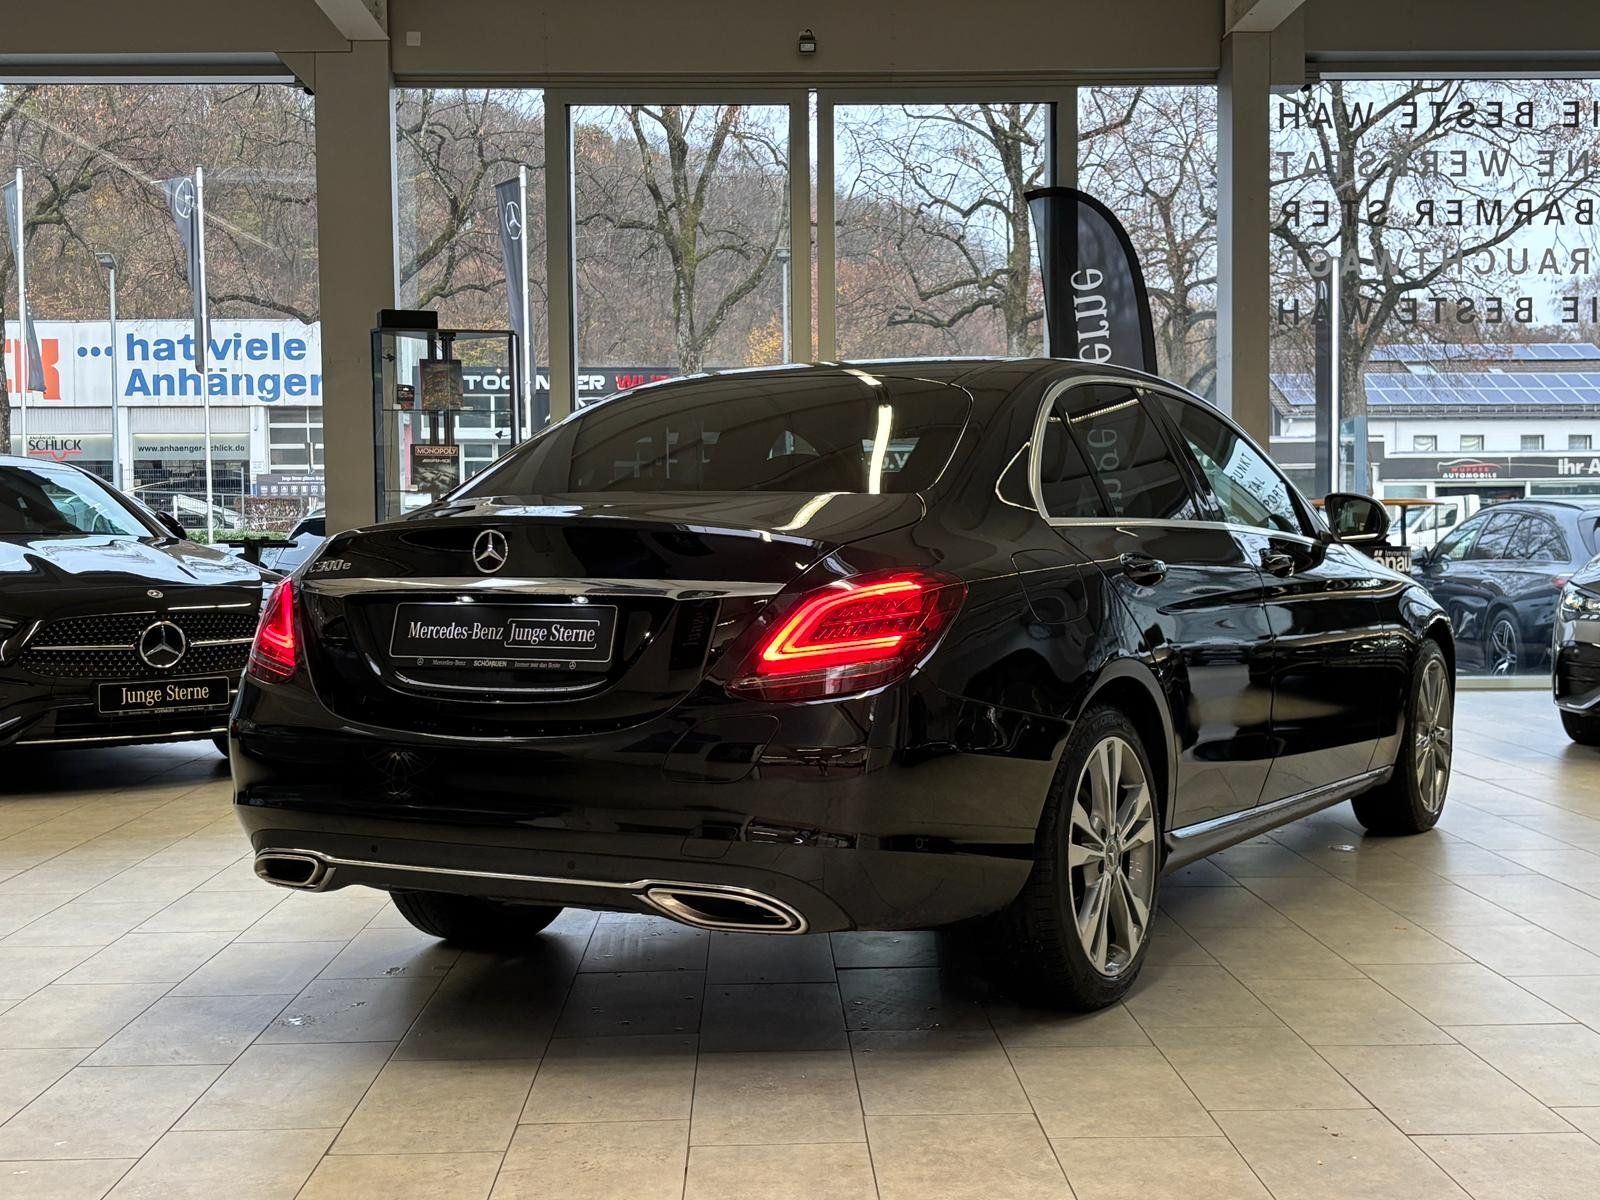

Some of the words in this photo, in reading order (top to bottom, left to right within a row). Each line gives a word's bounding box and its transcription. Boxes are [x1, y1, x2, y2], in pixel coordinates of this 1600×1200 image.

[126, 333, 196, 361] hat
[209, 332, 307, 361] viele
[125, 368, 322, 402] Anhänger
[28, 439, 81, 451] SCHLICK
[138, 444, 245, 454] www.anhaenger-chlick.de
[416, 447, 457, 455] MONOPOLY
[1558, 457, 1584, 475] Ihr
[408, 621, 504, 640] Mercedes-Benz
[508, 623, 547, 645] Junge
[550, 624, 595, 643] Sterne
[121, 687, 162, 706] Junge
[166, 684, 209, 701] Sterne
